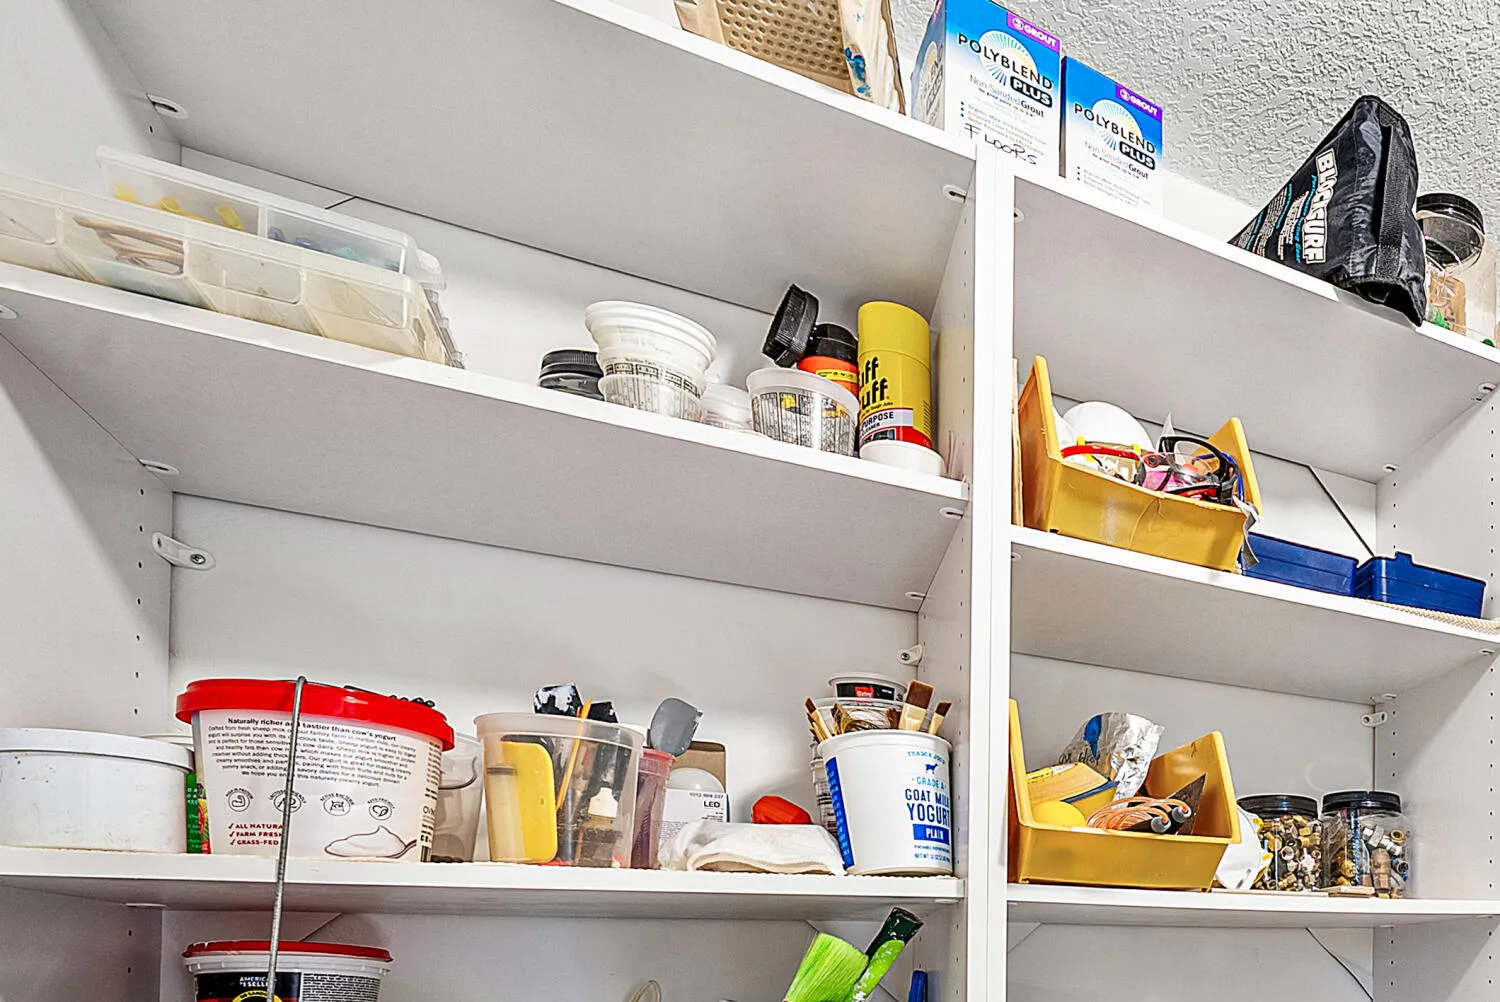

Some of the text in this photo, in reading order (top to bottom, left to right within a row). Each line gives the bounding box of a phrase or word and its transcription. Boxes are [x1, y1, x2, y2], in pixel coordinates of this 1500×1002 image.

[1023, 22, 1057, 48] GROUT
[958, 33, 1052, 90] POLYBLEND
[1013, 79, 1050, 105] PLUS
[1021, 100, 1044, 117] Grout
[1130, 95, 1158, 116] GROUT
[1074, 103, 1155, 153] POLYBLEND
[1122, 146, 1154, 168] PLUS
[1302, 148, 1338, 264] BLOCKSURF
[302, 722, 330, 730] tastier
[352, 729, 373, 737] cow's
[374, 733, 397, 741] yogurt
[916, 776, 939, 789] GRADE
[703, 800, 721, 808] LED
[905, 788, 931, 802] GOAT
[906, 802, 950, 827] YOGURT
